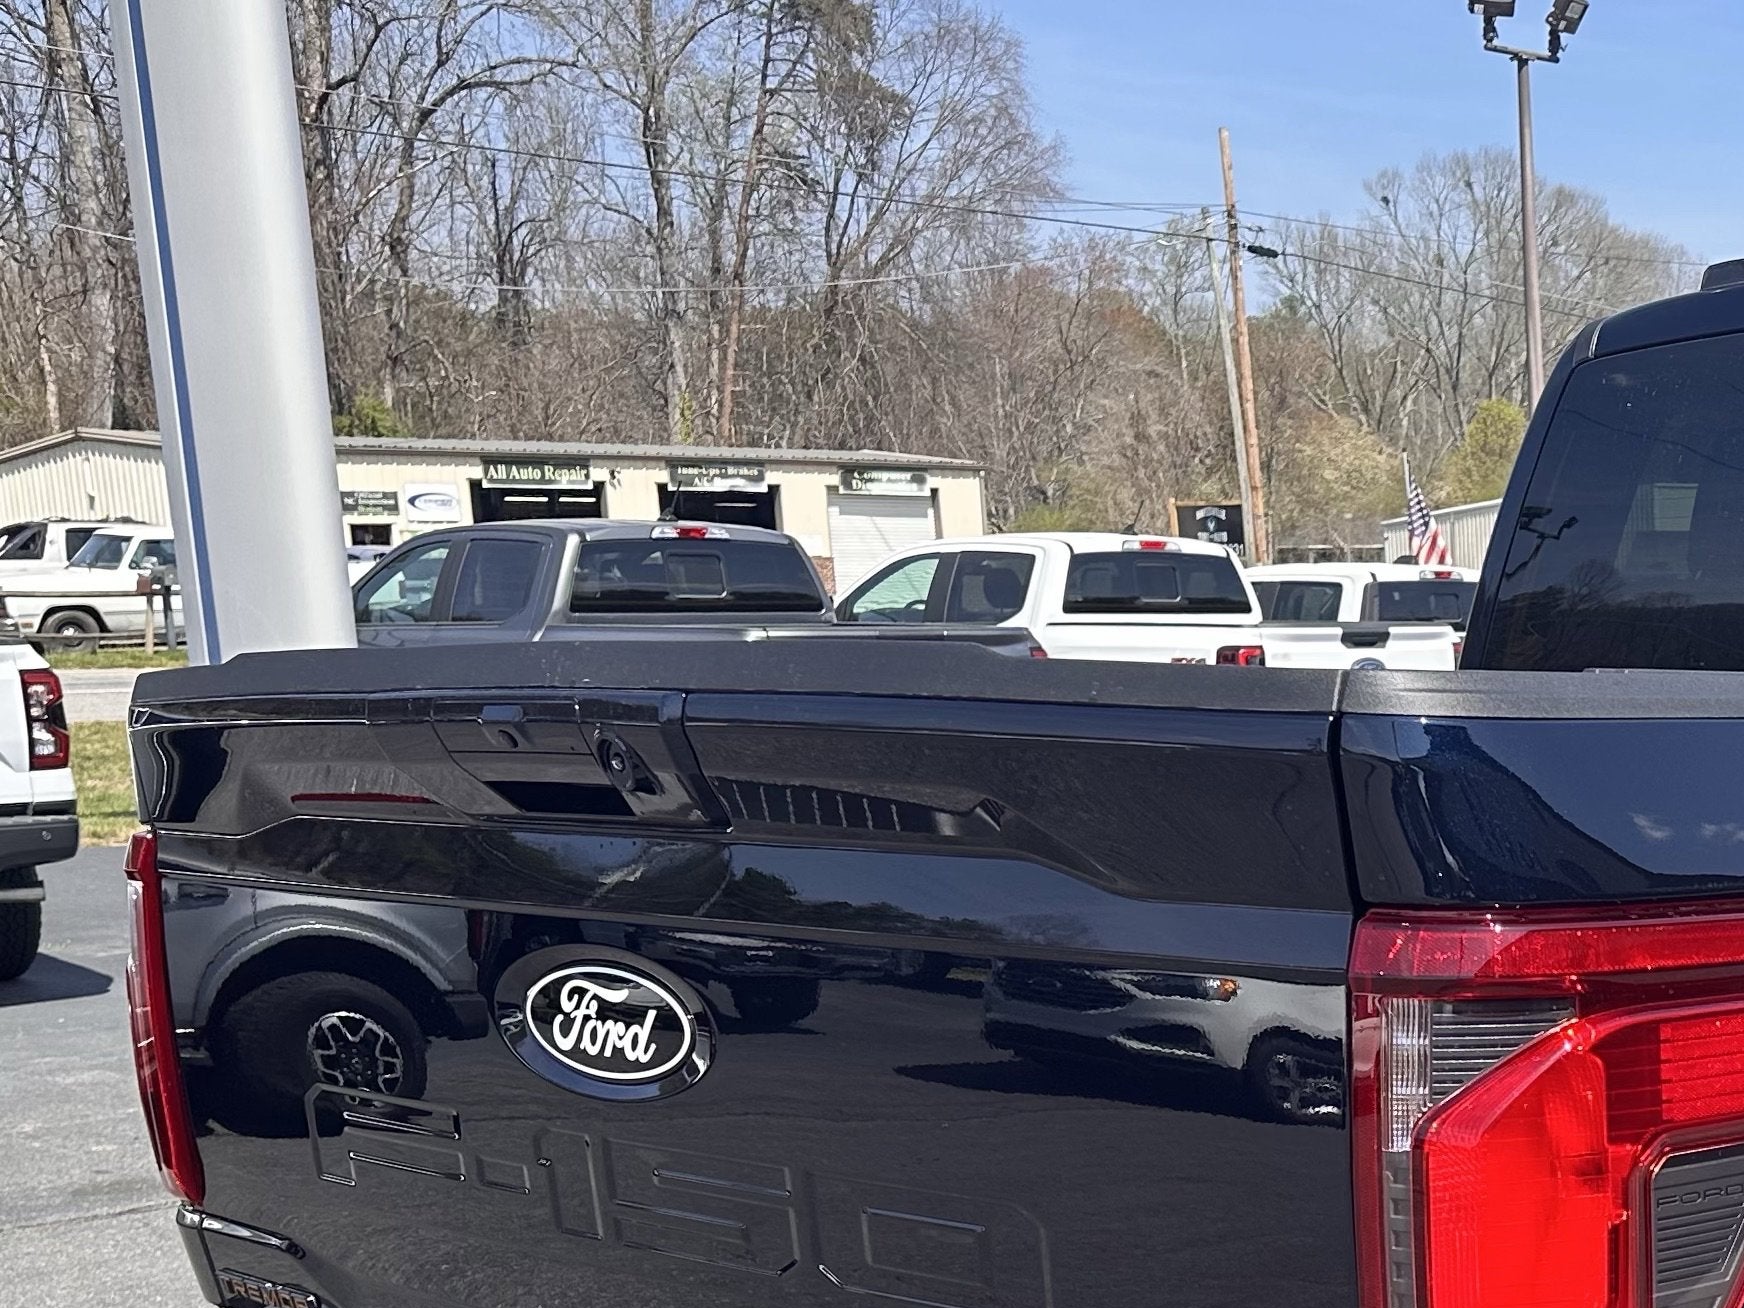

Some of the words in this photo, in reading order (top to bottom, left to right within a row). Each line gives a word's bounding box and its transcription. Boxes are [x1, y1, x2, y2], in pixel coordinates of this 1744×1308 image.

[487, 464, 506, 480] All
[509, 464, 542, 480] Auto
[544, 465, 588, 484] Repair
[552, 979, 658, 1064] Ford
[1656, 1184, 1744, 1209] FORD
